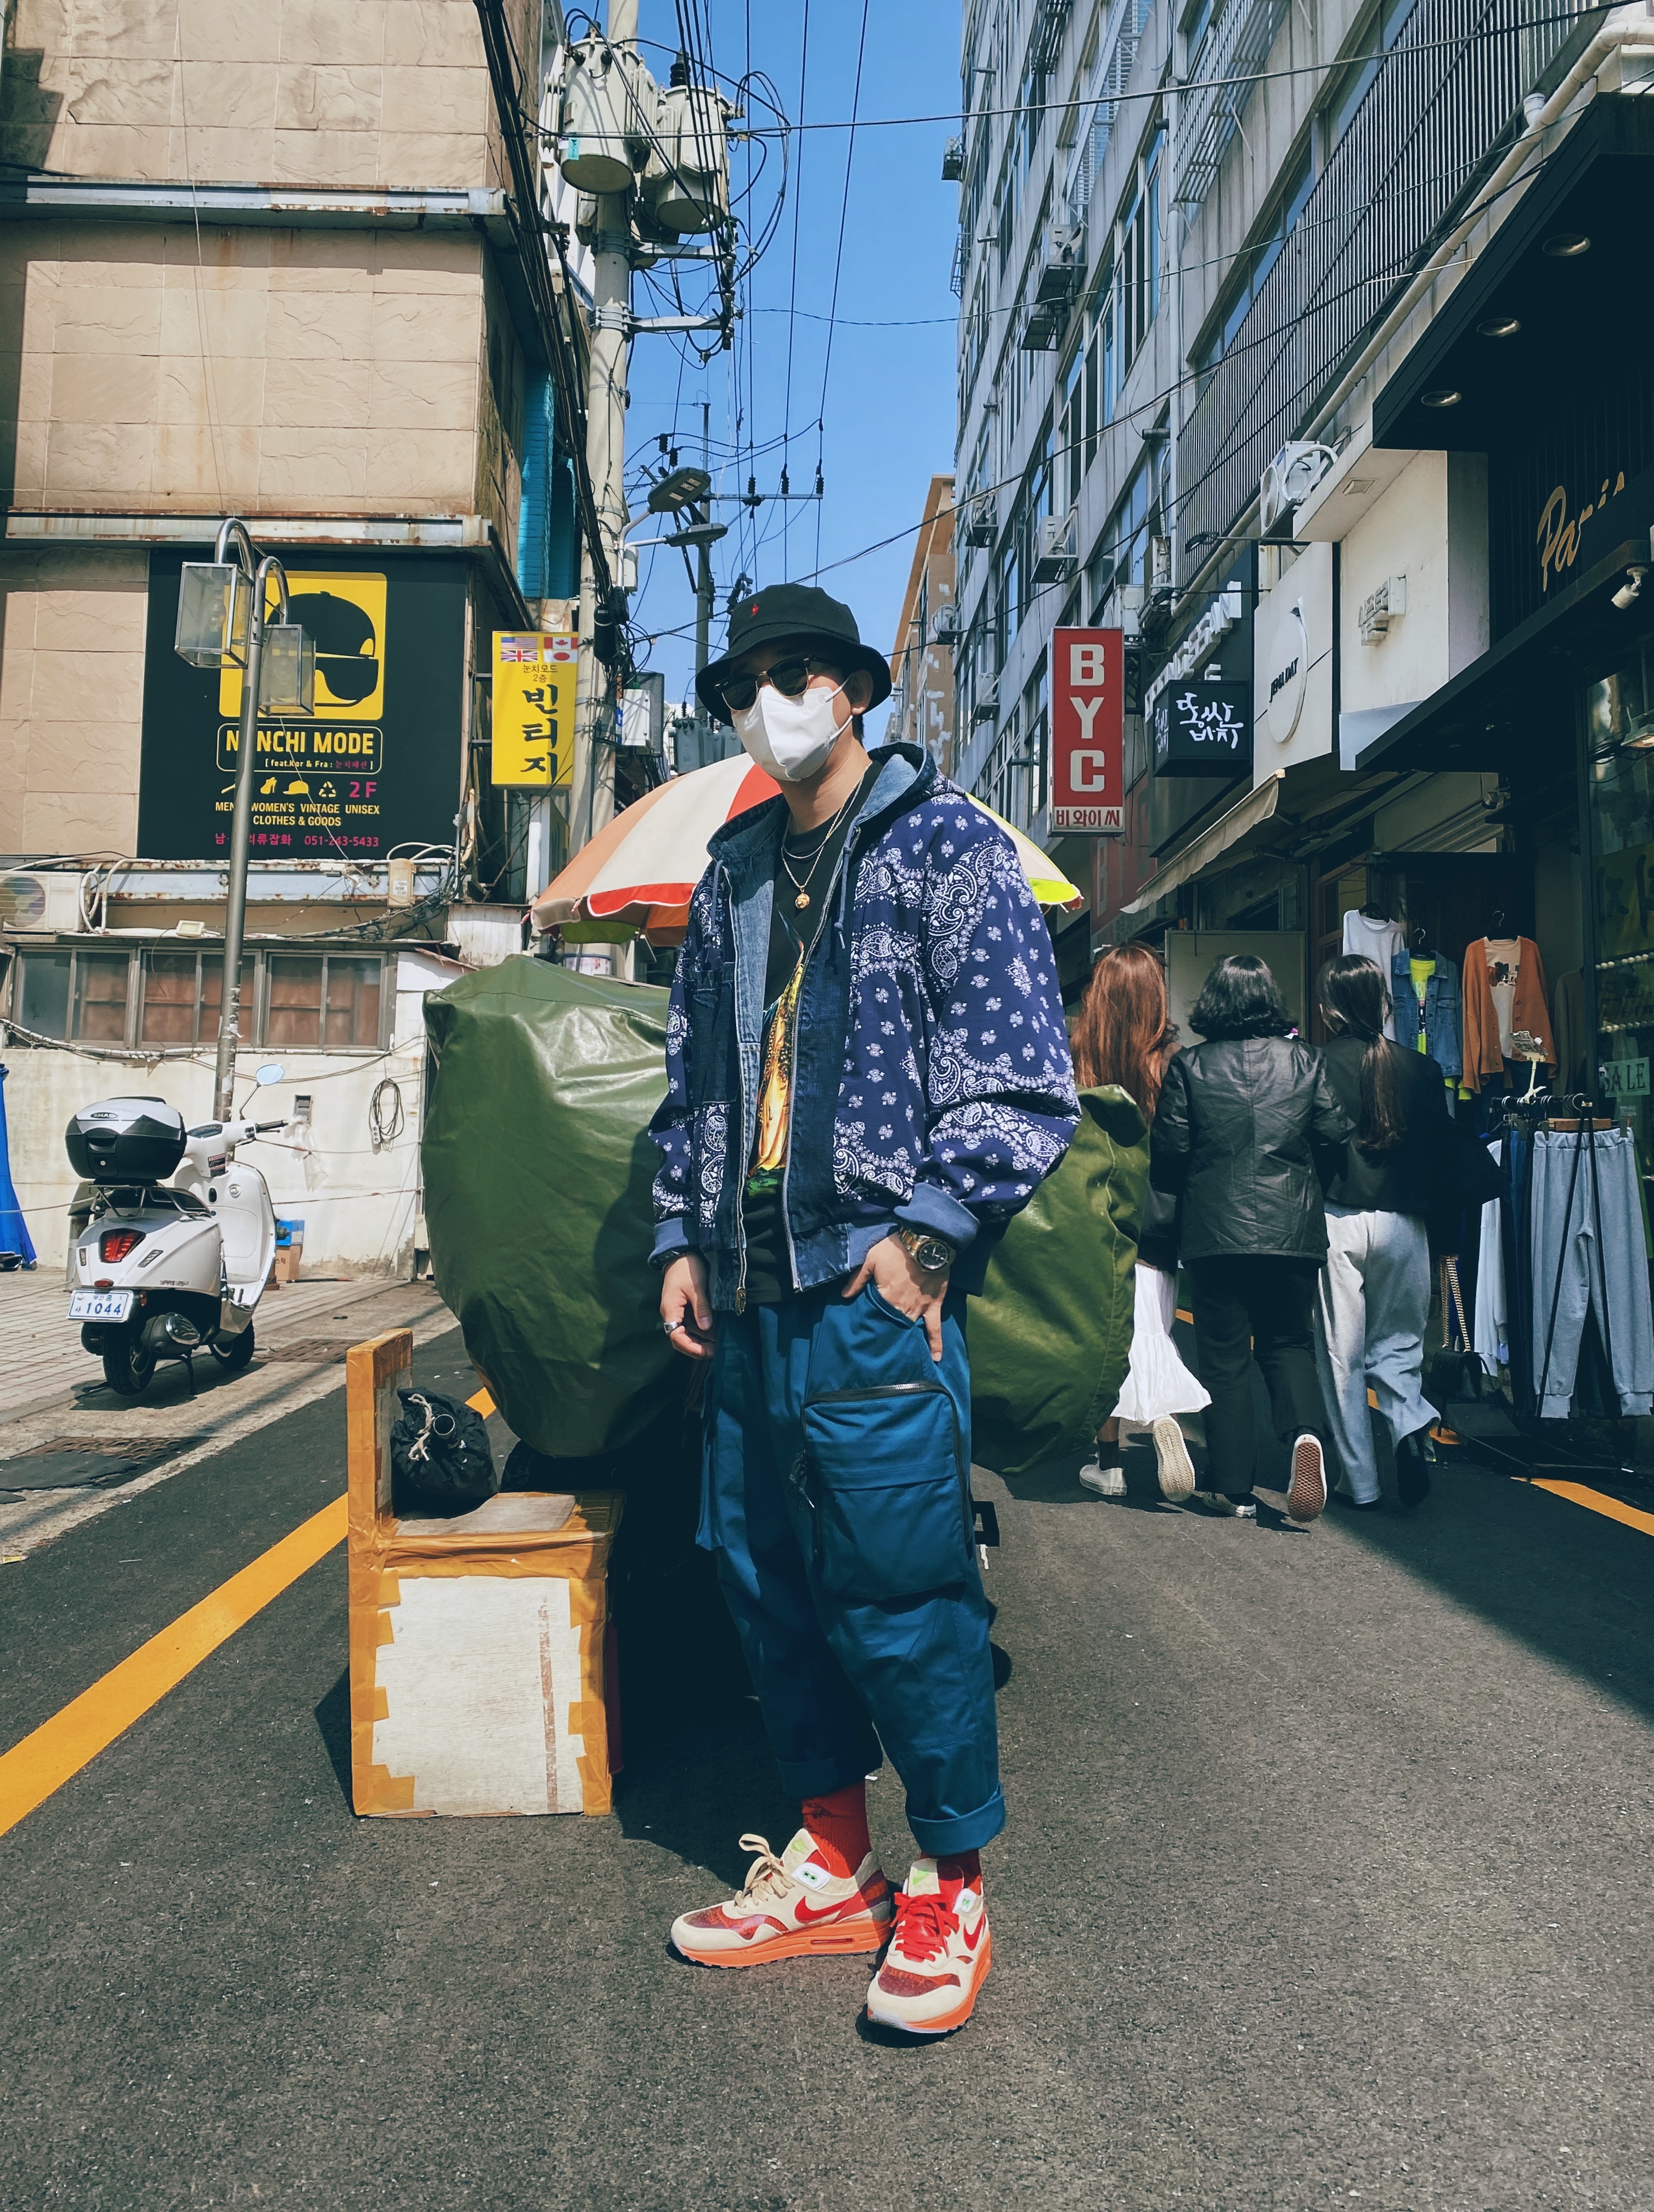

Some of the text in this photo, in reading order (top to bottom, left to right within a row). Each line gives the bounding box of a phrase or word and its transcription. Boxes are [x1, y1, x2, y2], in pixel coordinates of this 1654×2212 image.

[523, 664, 557, 673] 눈치모드
[533, 674, 547, 683] 2층
[1070, 644, 1105, 792] BYC
[521, 684, 558, 784] 빈티지
[226, 730, 374, 754] NNCHI MODE
[251, 803, 295, 812] WOMEN'S
[300, 803, 340, 813] VINTAGE
[345, 804, 380, 815] UNISEX
[253, 816, 341, 826] CLOTHES & GOODS
[1056, 810, 1120, 827] 비와이씨
[304, 836, 379, 847] 051-243-5433
[87, 1302, 121, 1315] 1044
